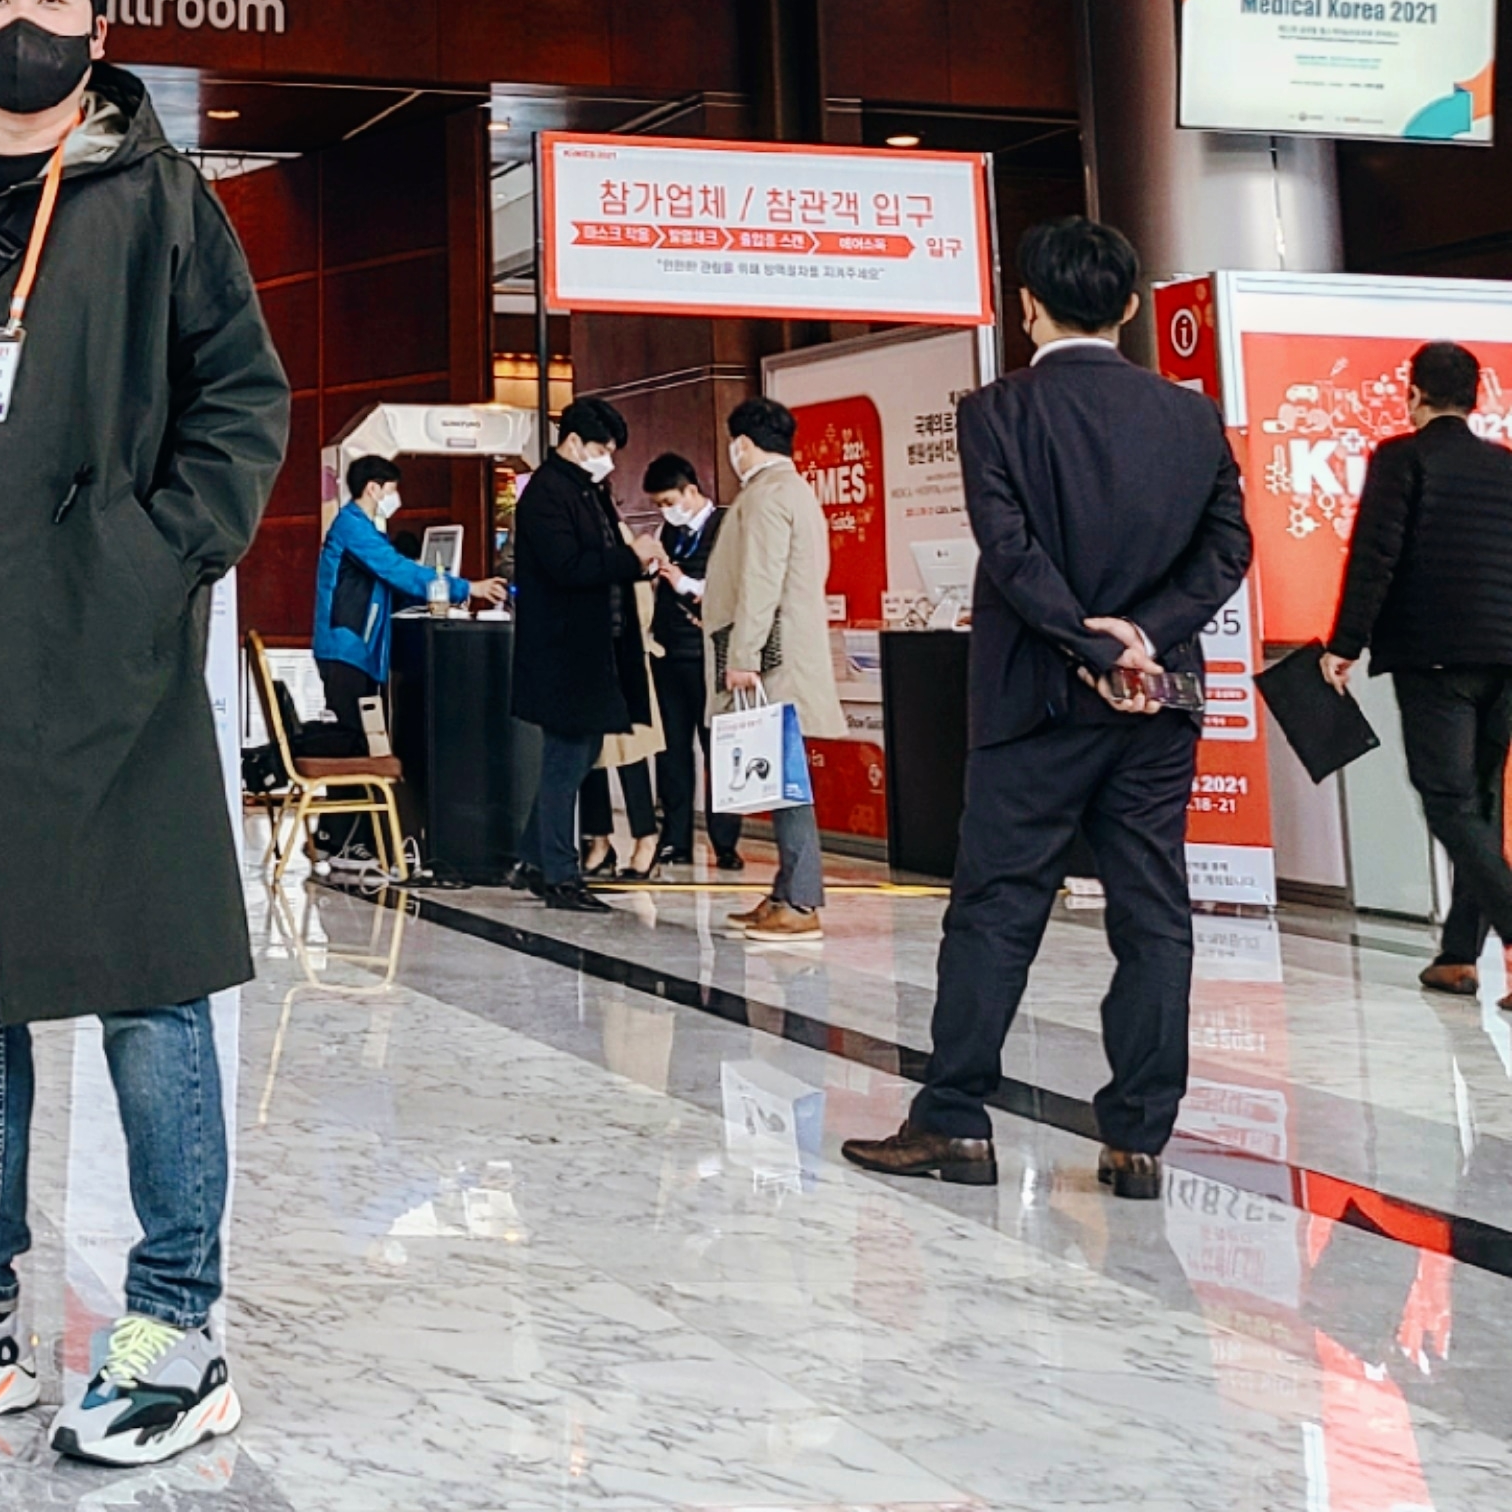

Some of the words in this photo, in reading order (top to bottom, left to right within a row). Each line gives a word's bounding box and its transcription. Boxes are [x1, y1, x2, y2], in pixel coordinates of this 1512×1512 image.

[1391, 0, 1438, 25] 2021
[599, 179, 727, 220] 참가업체
[738, 186, 755, 223] /
[766, 187, 861, 227] 참관객
[872, 192, 934, 228] 입구
[925, 237, 964, 259] 입구
[1200, 774, 1248, 795] 2021
